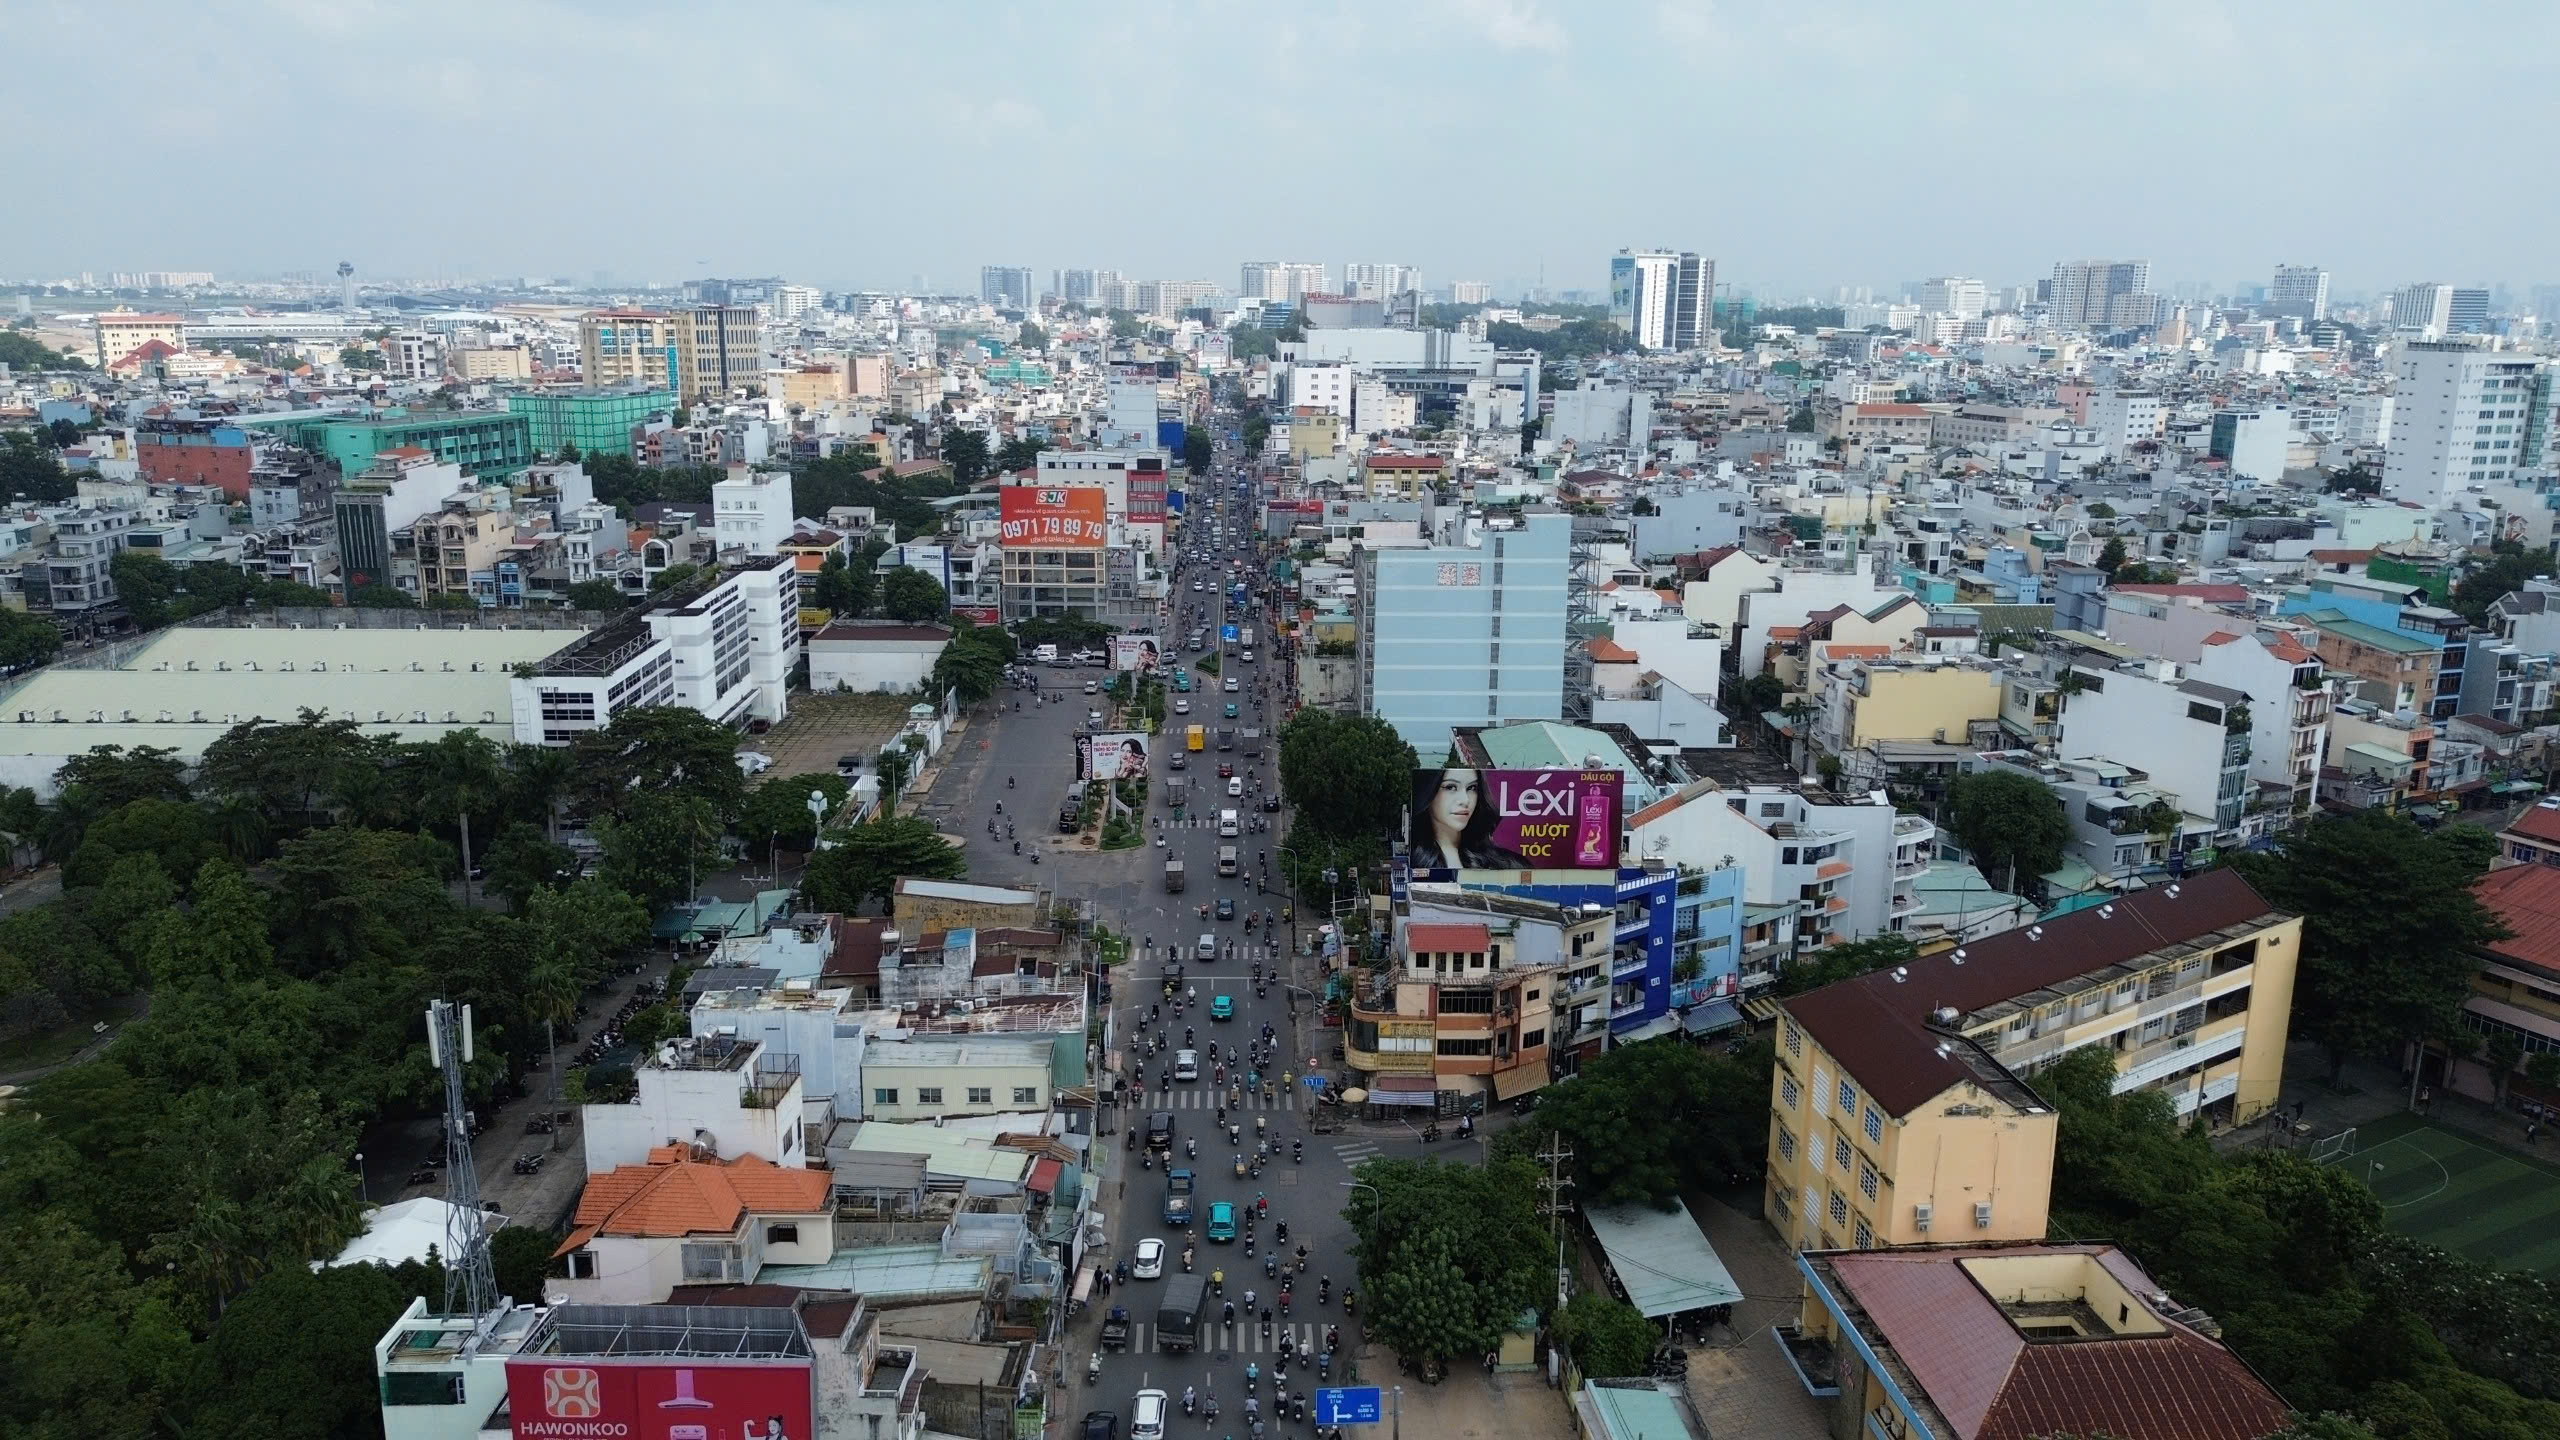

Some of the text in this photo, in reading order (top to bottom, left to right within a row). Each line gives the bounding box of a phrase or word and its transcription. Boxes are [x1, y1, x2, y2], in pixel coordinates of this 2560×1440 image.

[1038, 491, 1066, 503] SJK
[1002, 517, 1103, 540] 0971 79 89 79
[1080, 738, 1092, 780] Omachi
[1600, 773, 1615, 784] GỘI
[1500, 773, 1575, 817] Léxi
[1520, 823, 1570, 840] MƯỢT
[1520, 843, 1551, 857] TÓC
[520, 1421, 628, 1436] HAWONKOO
